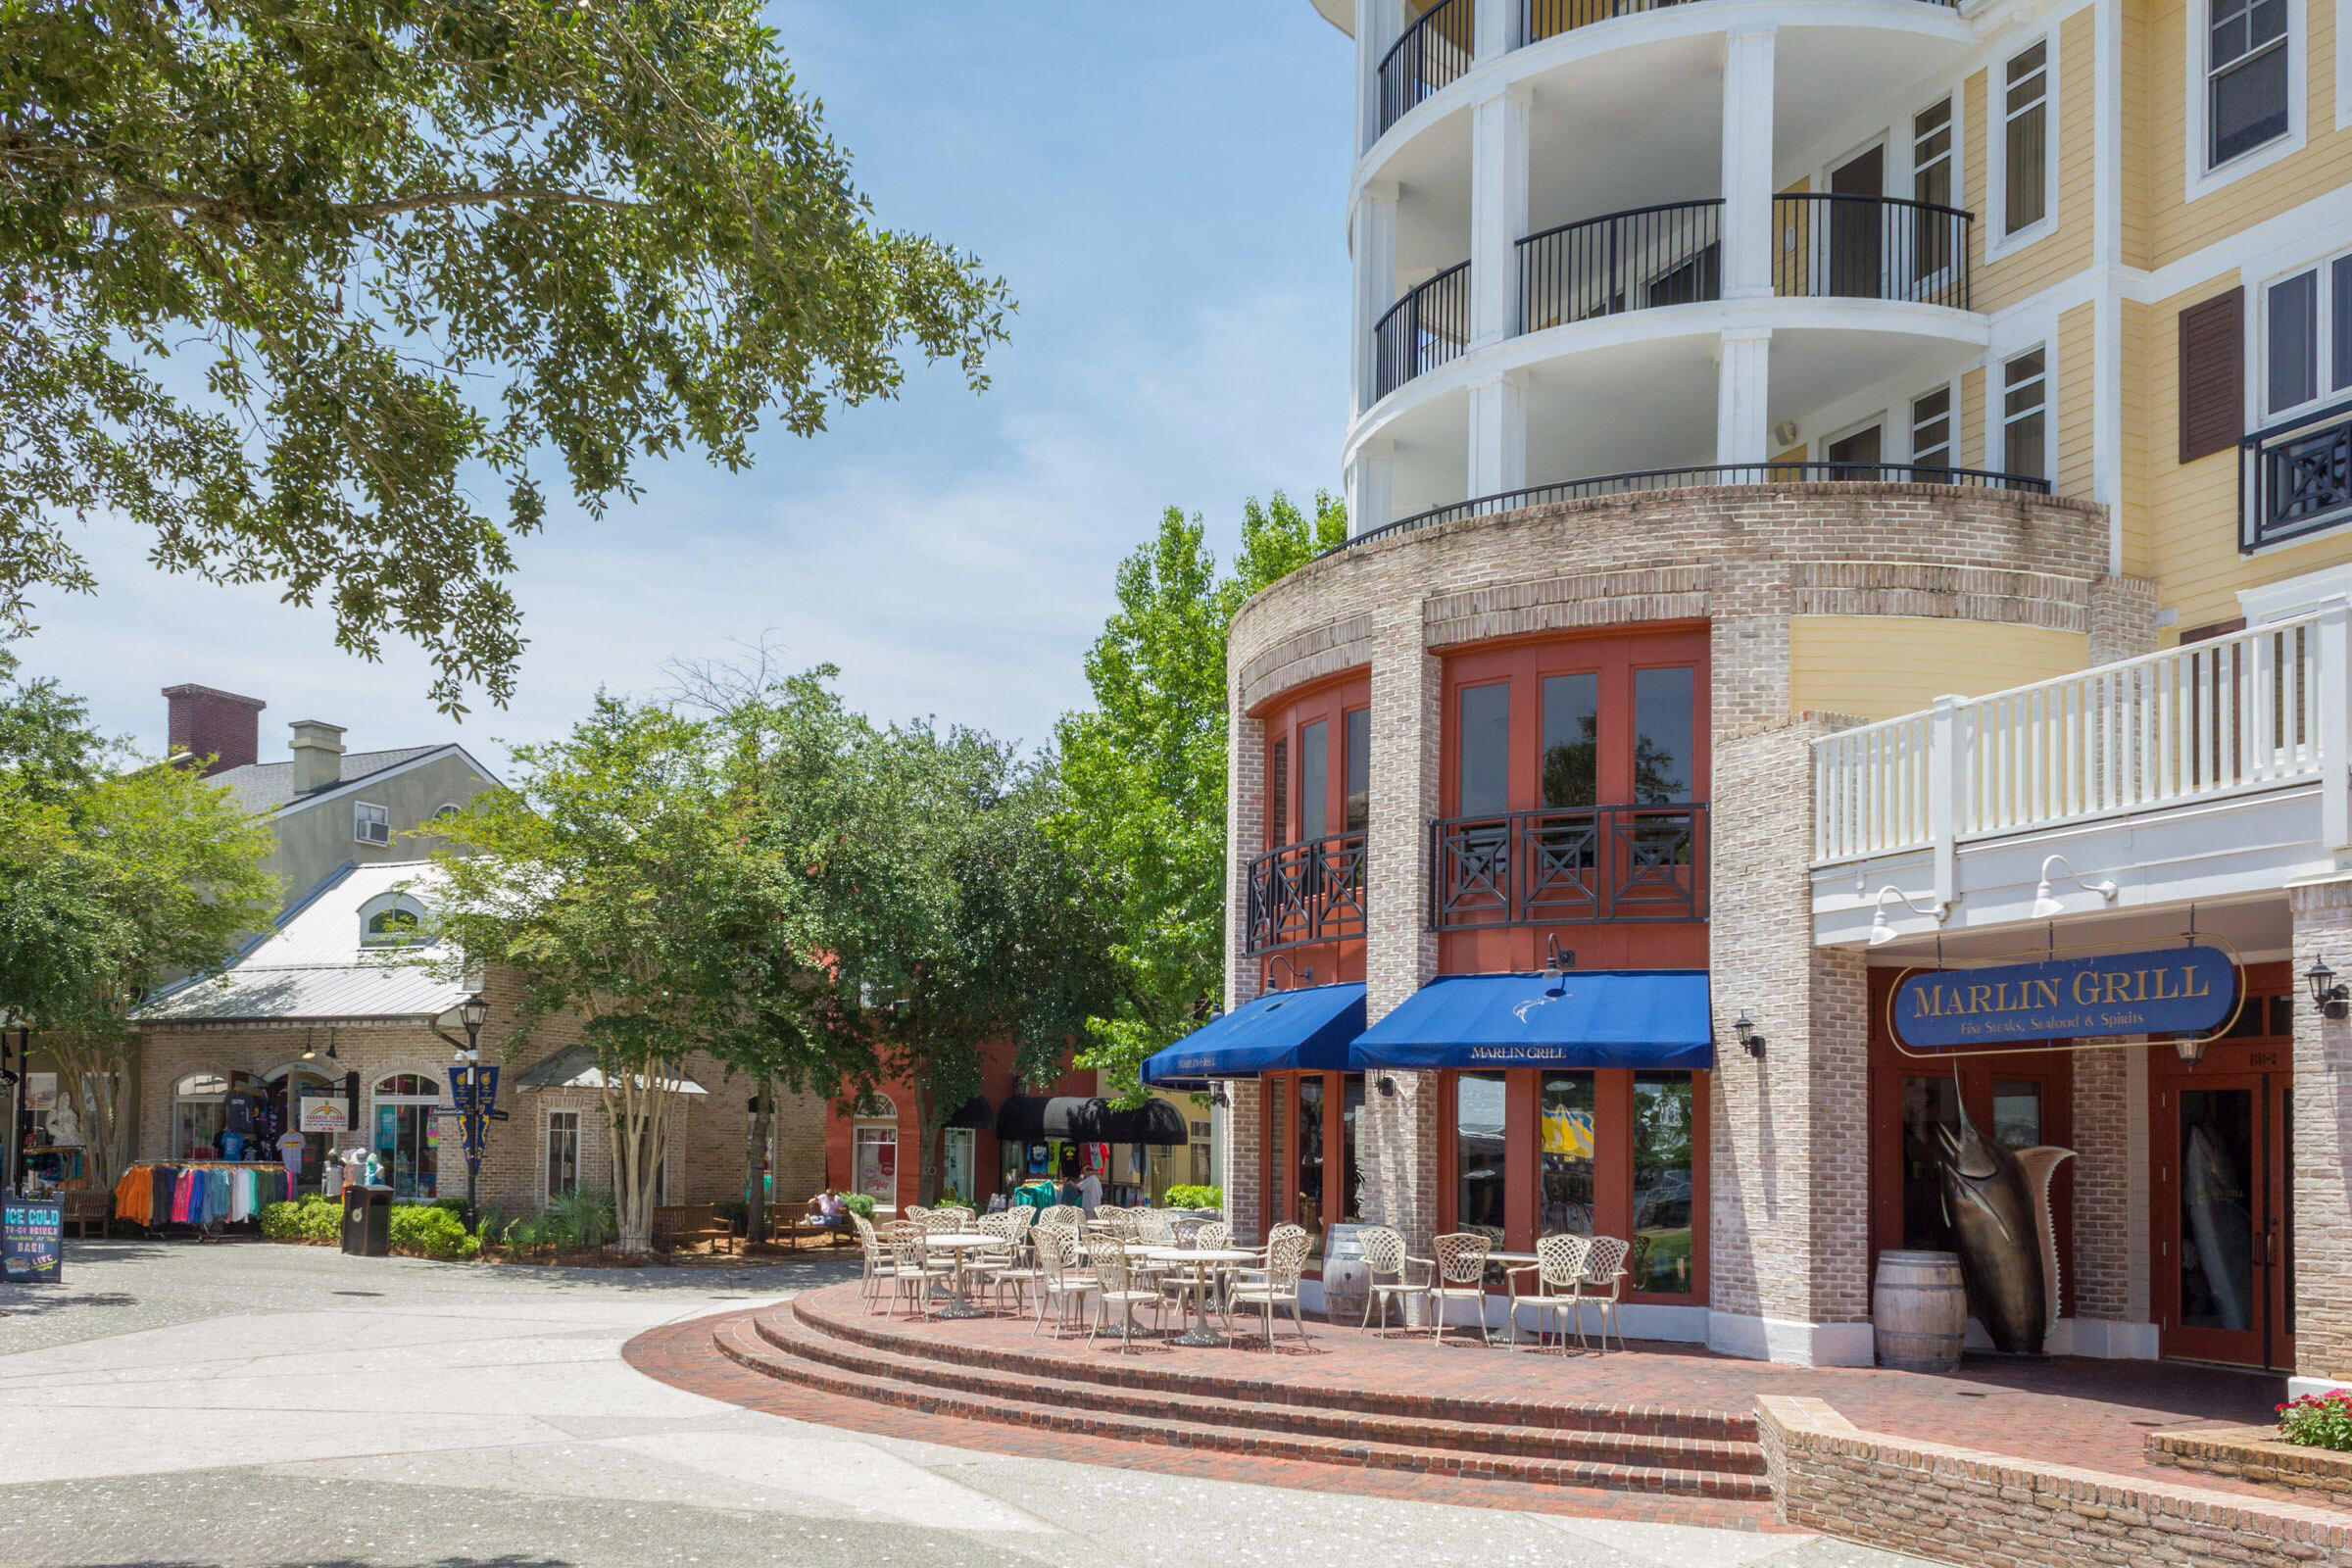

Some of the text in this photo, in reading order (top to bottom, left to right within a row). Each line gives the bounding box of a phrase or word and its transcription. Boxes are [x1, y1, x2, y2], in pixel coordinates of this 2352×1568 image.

[1913, 965, 2209, 1018] MARLIN GRILL
[2084, 1015, 2094, 1027] &
[1471, 1047, 1567, 1058] MARLIN GRILL
[5, 1207, 59, 1225] ICE COLD
[32, 1254, 53, 1264] LIVE
